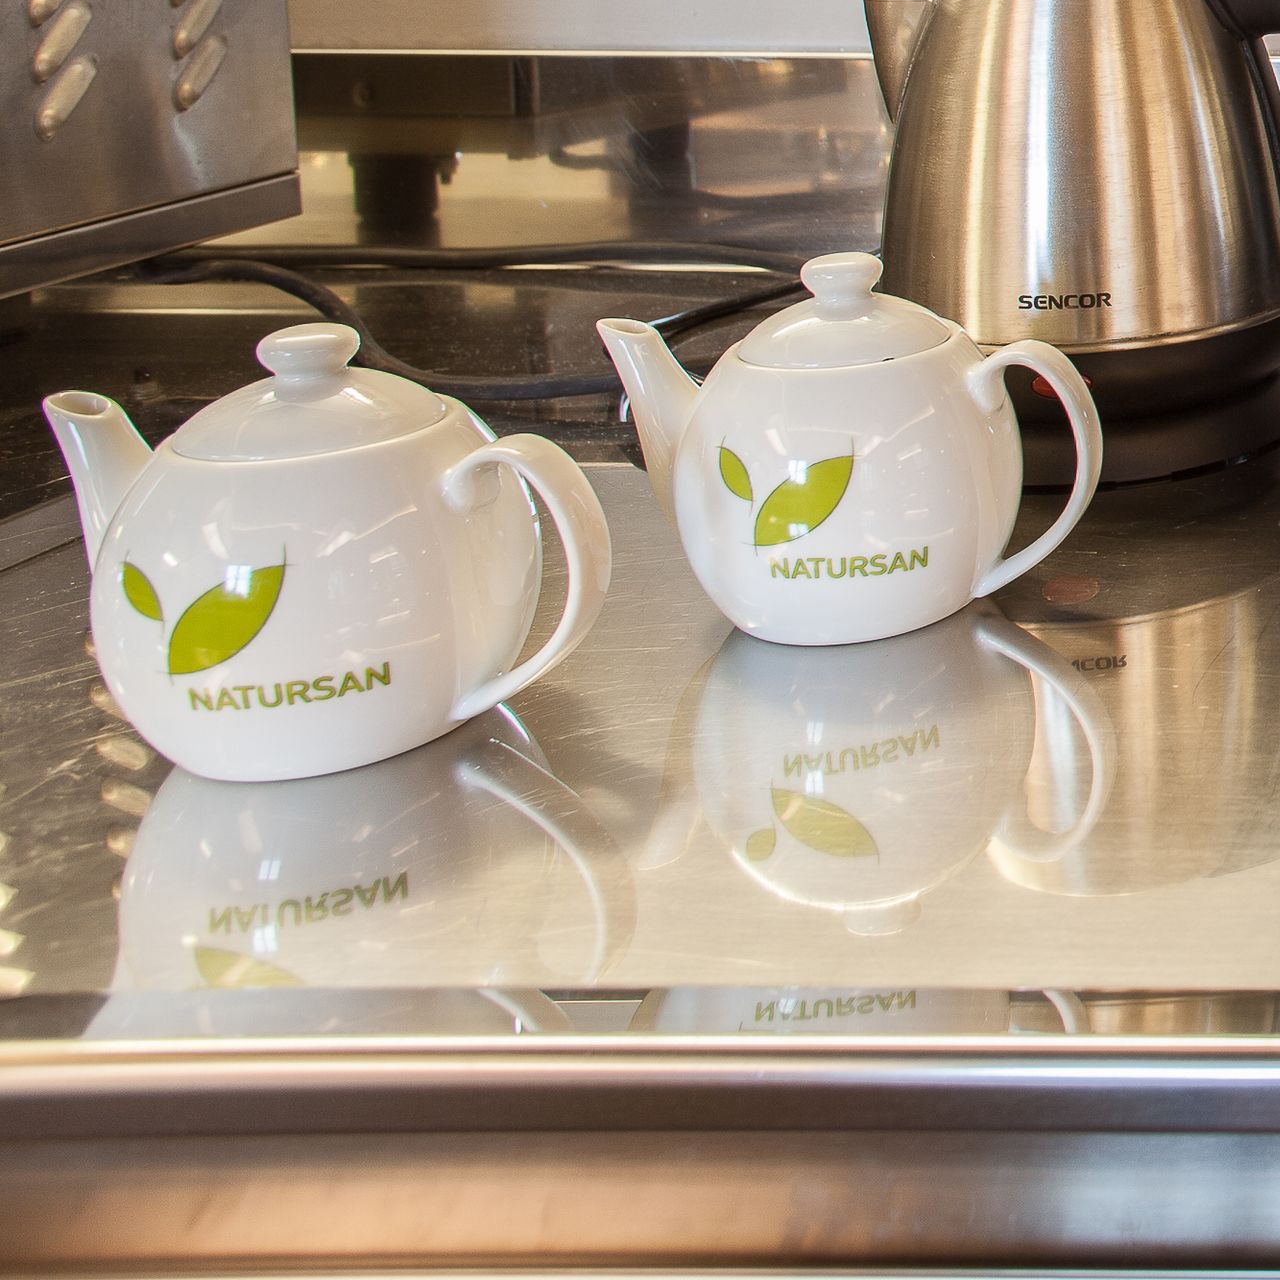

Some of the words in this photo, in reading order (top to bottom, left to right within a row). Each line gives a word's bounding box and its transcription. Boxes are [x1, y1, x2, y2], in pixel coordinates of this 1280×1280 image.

[1018, 292, 1113, 310] SENCOR
[770, 546, 930, 580] NATURSAN
[187, 661, 393, 712] NATURSAN
